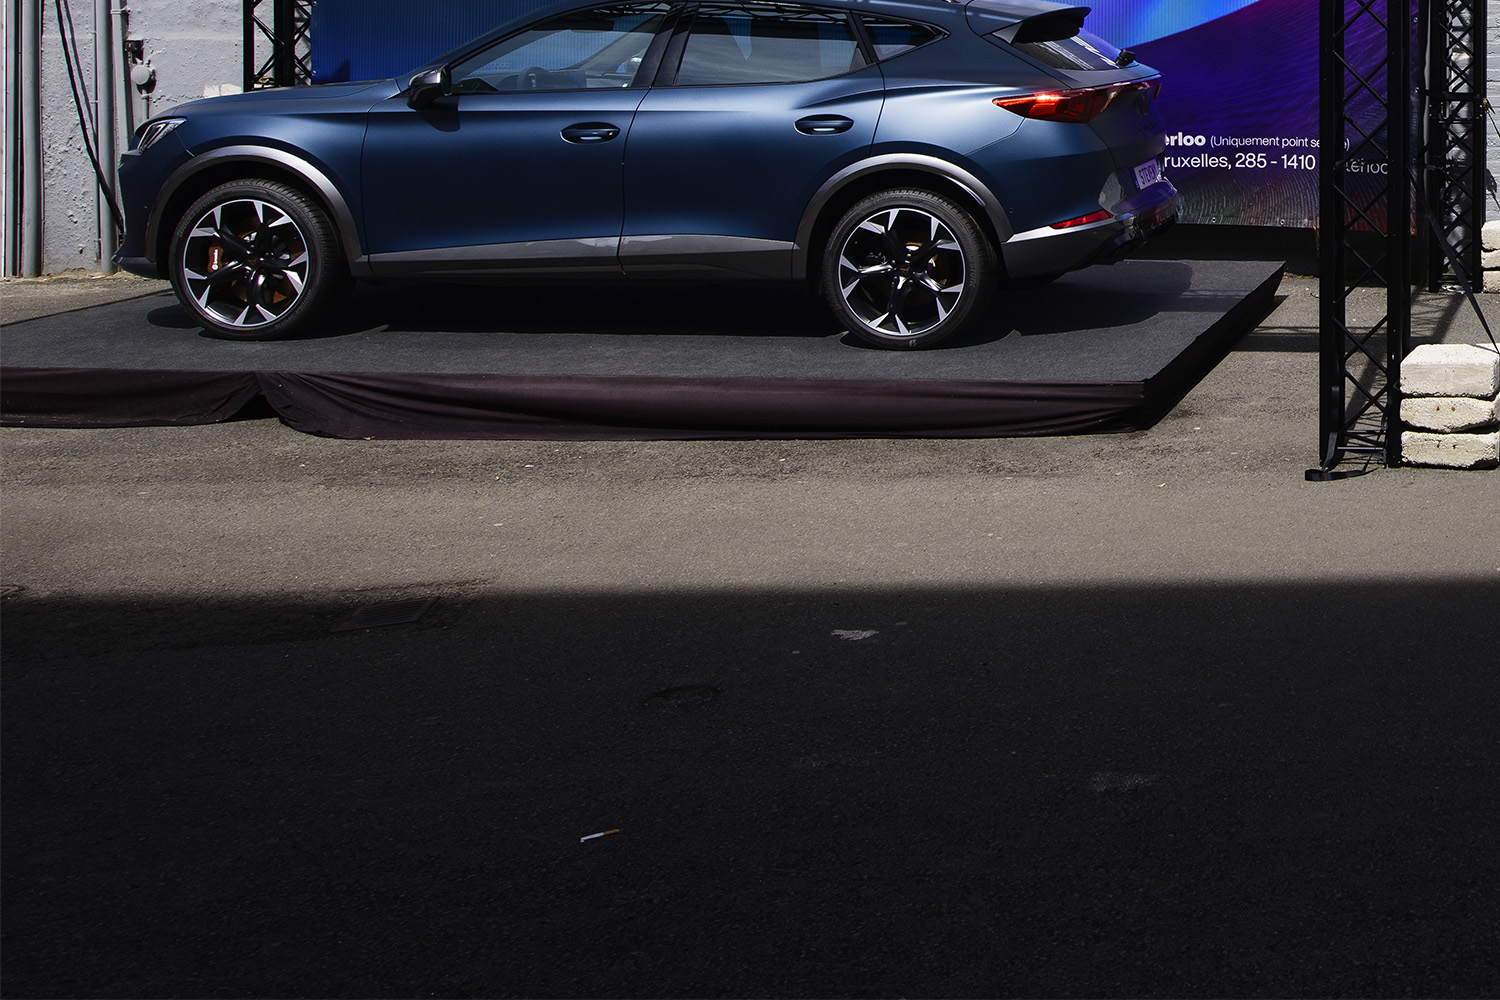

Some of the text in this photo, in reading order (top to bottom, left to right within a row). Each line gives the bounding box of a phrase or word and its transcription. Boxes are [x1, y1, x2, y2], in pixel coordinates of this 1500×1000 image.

[1210, 135, 1280, 149] (Uniquement
[1281, 136, 1309, 149] point
[1164, 153, 1232, 170] ruxelles,
[1235, 152, 1267, 169] 285
[1280, 153, 1316, 170] 1410
